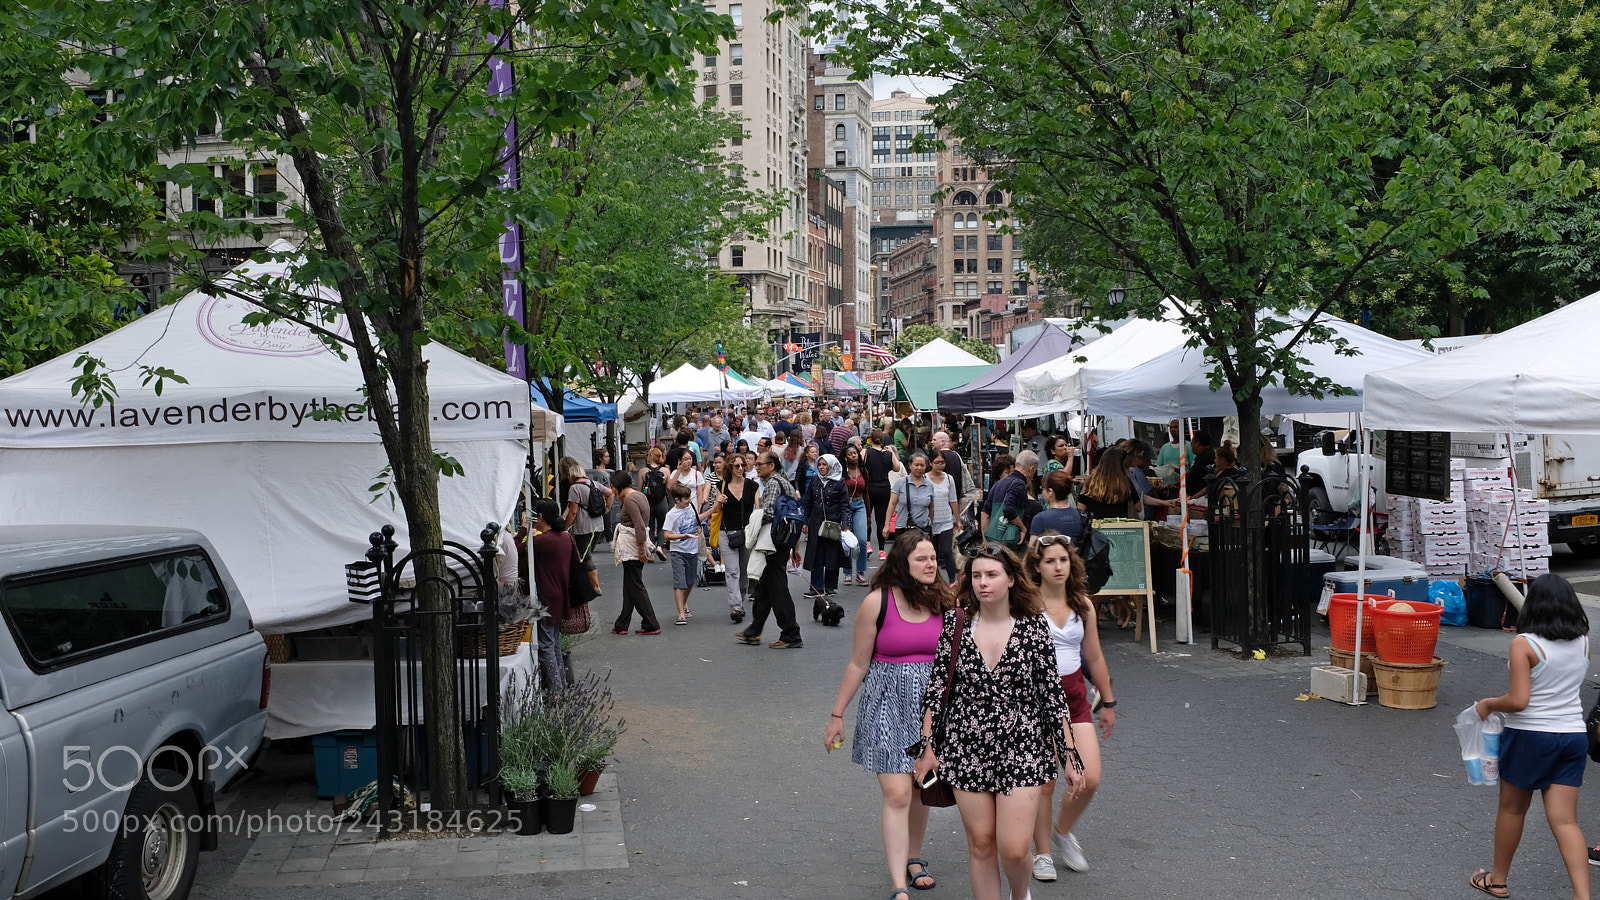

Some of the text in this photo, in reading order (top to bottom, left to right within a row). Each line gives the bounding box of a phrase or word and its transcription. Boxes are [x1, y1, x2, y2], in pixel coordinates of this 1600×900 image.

[253, 339, 292, 350] Bay
[865, 371, 893, 382] BERRIES
[4, 395, 513, 428] www.lavenderbythe.com
